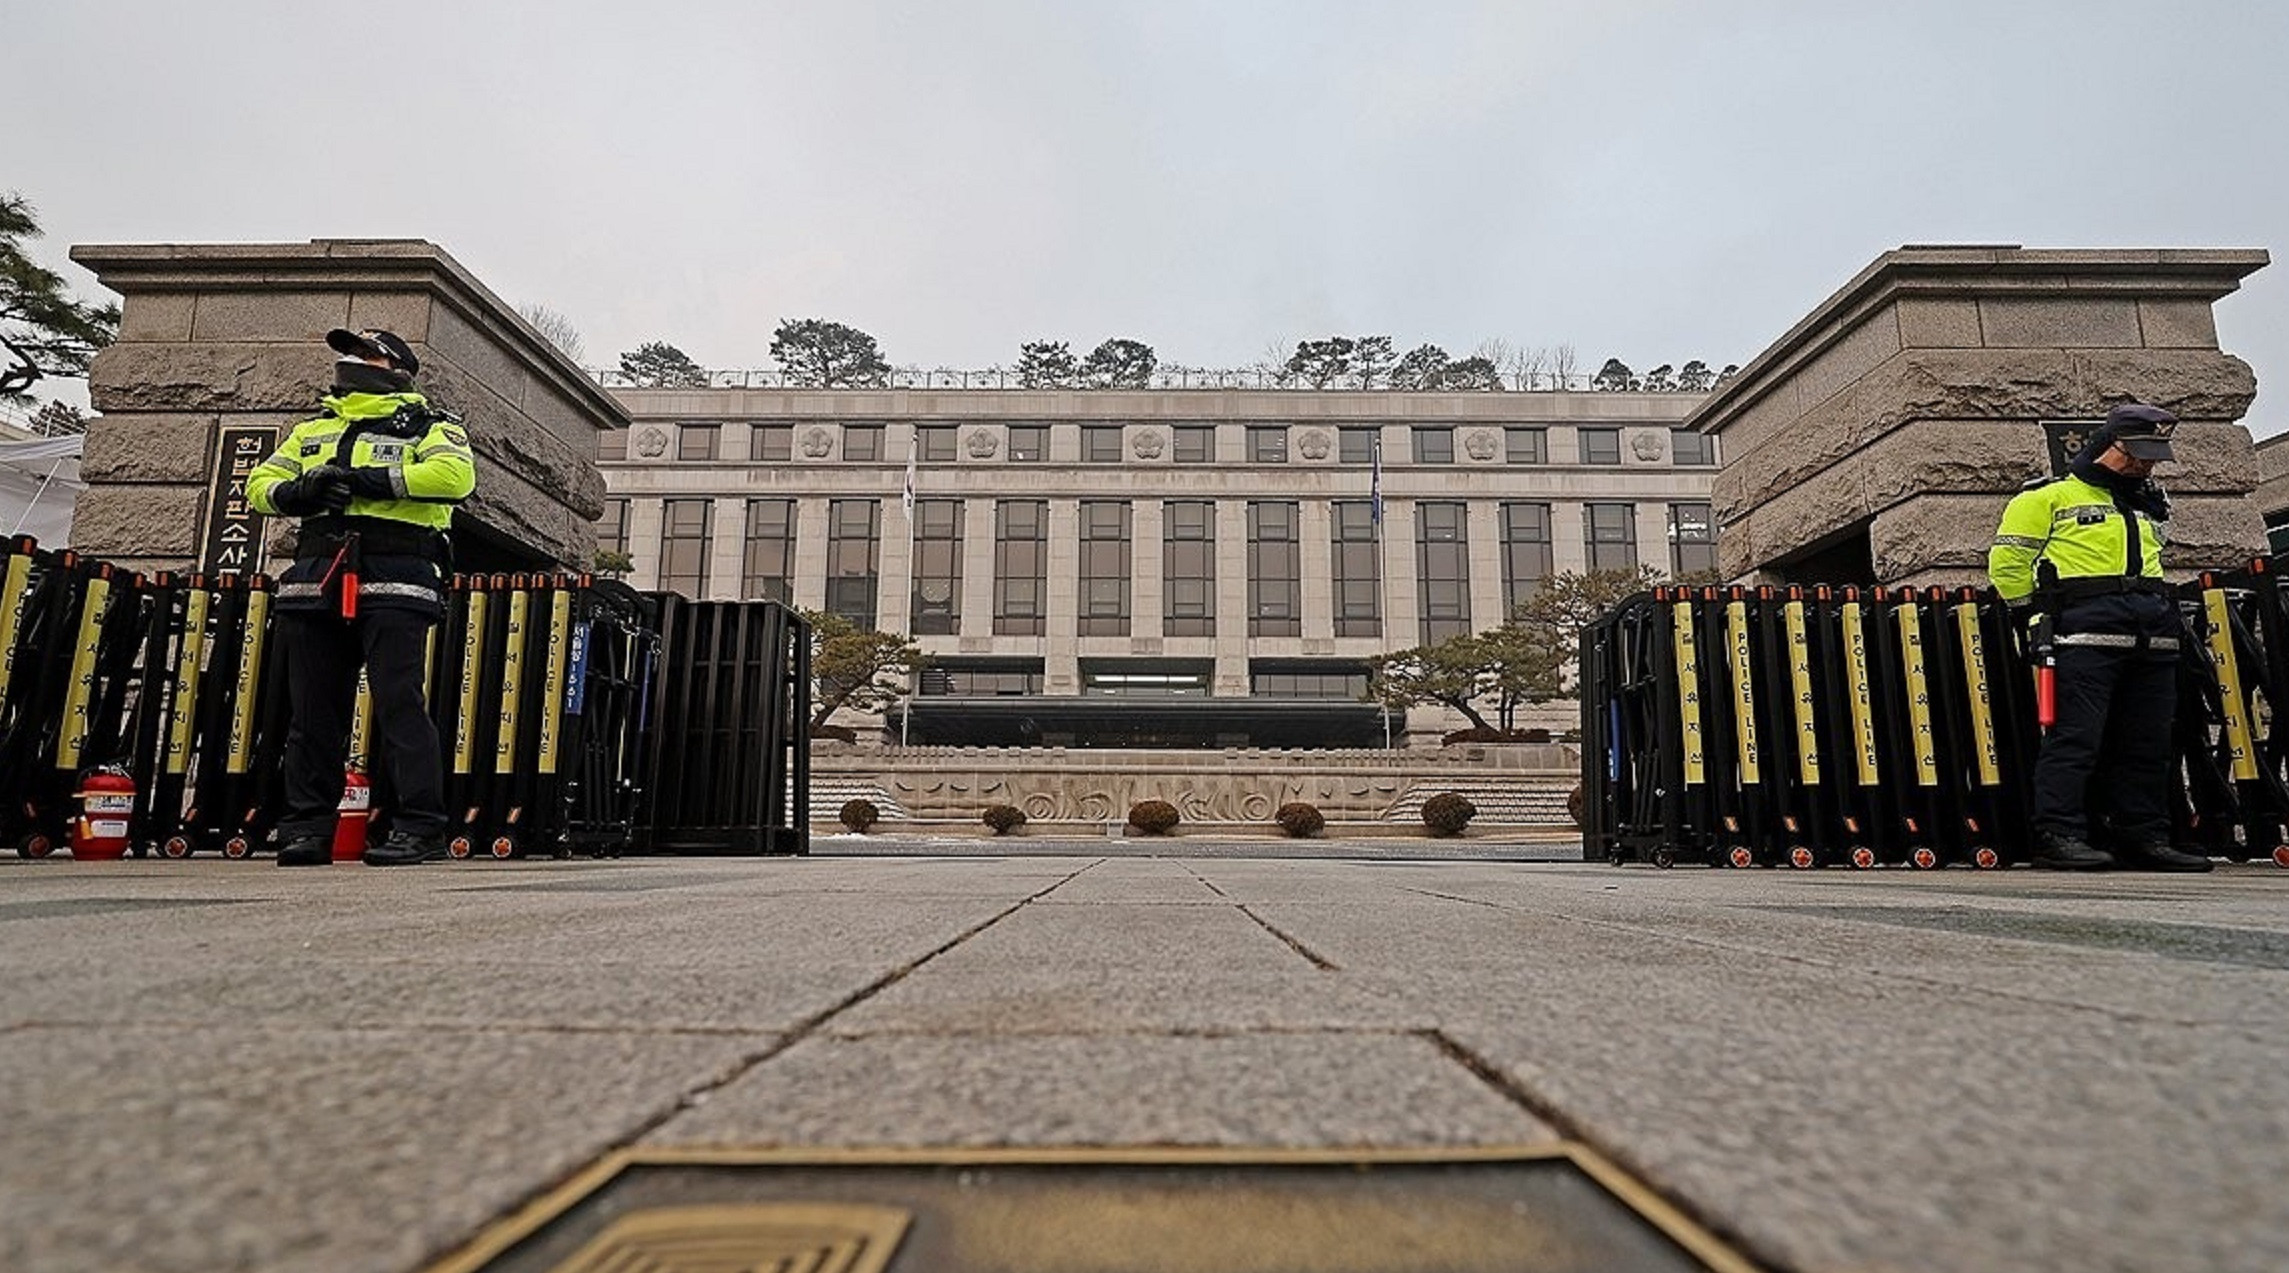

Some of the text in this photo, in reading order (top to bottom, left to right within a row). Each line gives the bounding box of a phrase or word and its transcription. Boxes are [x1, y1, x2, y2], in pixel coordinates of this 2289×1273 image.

[217, 436, 262, 575] 헌법판소사
[230, 623, 254, 754] POLICE LINE
[352, 706, 361, 753] LINE
[1737, 633, 1756, 763] POLICE LINE
[1853, 634, 1876, 765] POLICE LINE
[1971, 634, 1997, 765] POLICE LINE
